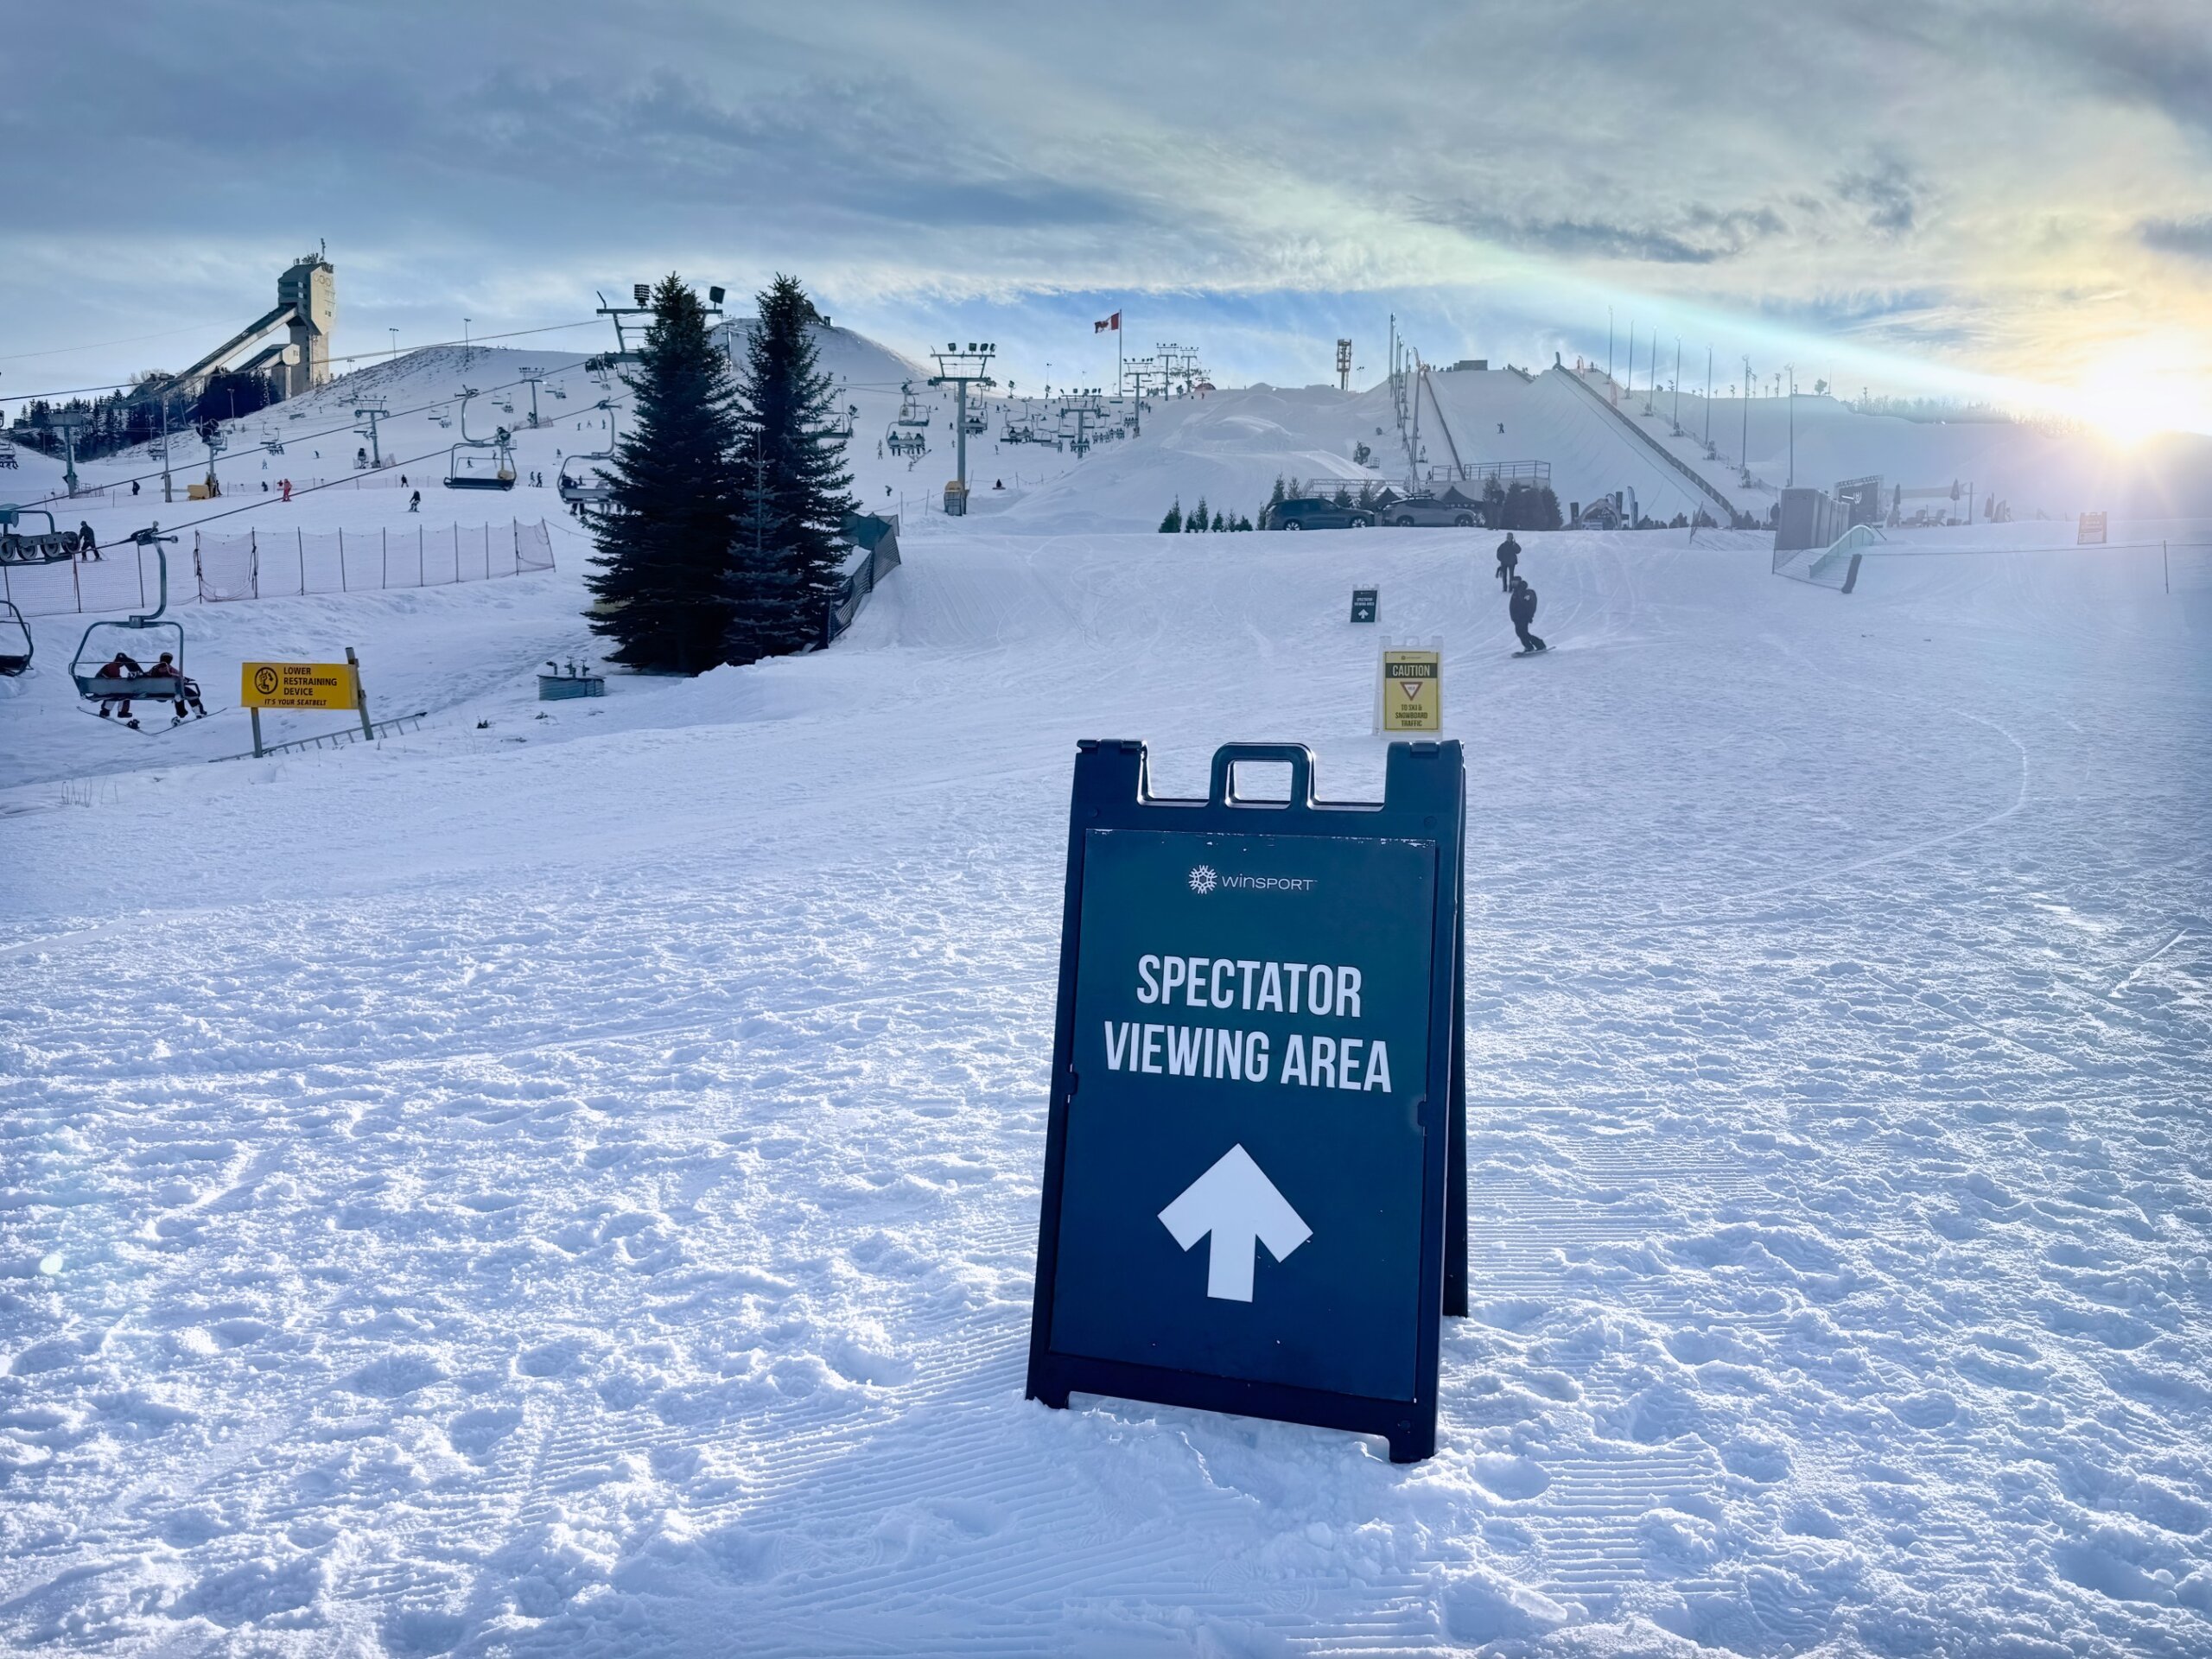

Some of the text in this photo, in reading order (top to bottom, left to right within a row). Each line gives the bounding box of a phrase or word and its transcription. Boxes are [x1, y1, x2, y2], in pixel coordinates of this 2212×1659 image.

[283, 677, 337, 686] RESTRAINING
[1392, 664, 1430, 677] CAUTION
[1136, 954, 1362, 1018] SPECTATOR
[1104, 1020, 1392, 1093] VIEWING AREA
